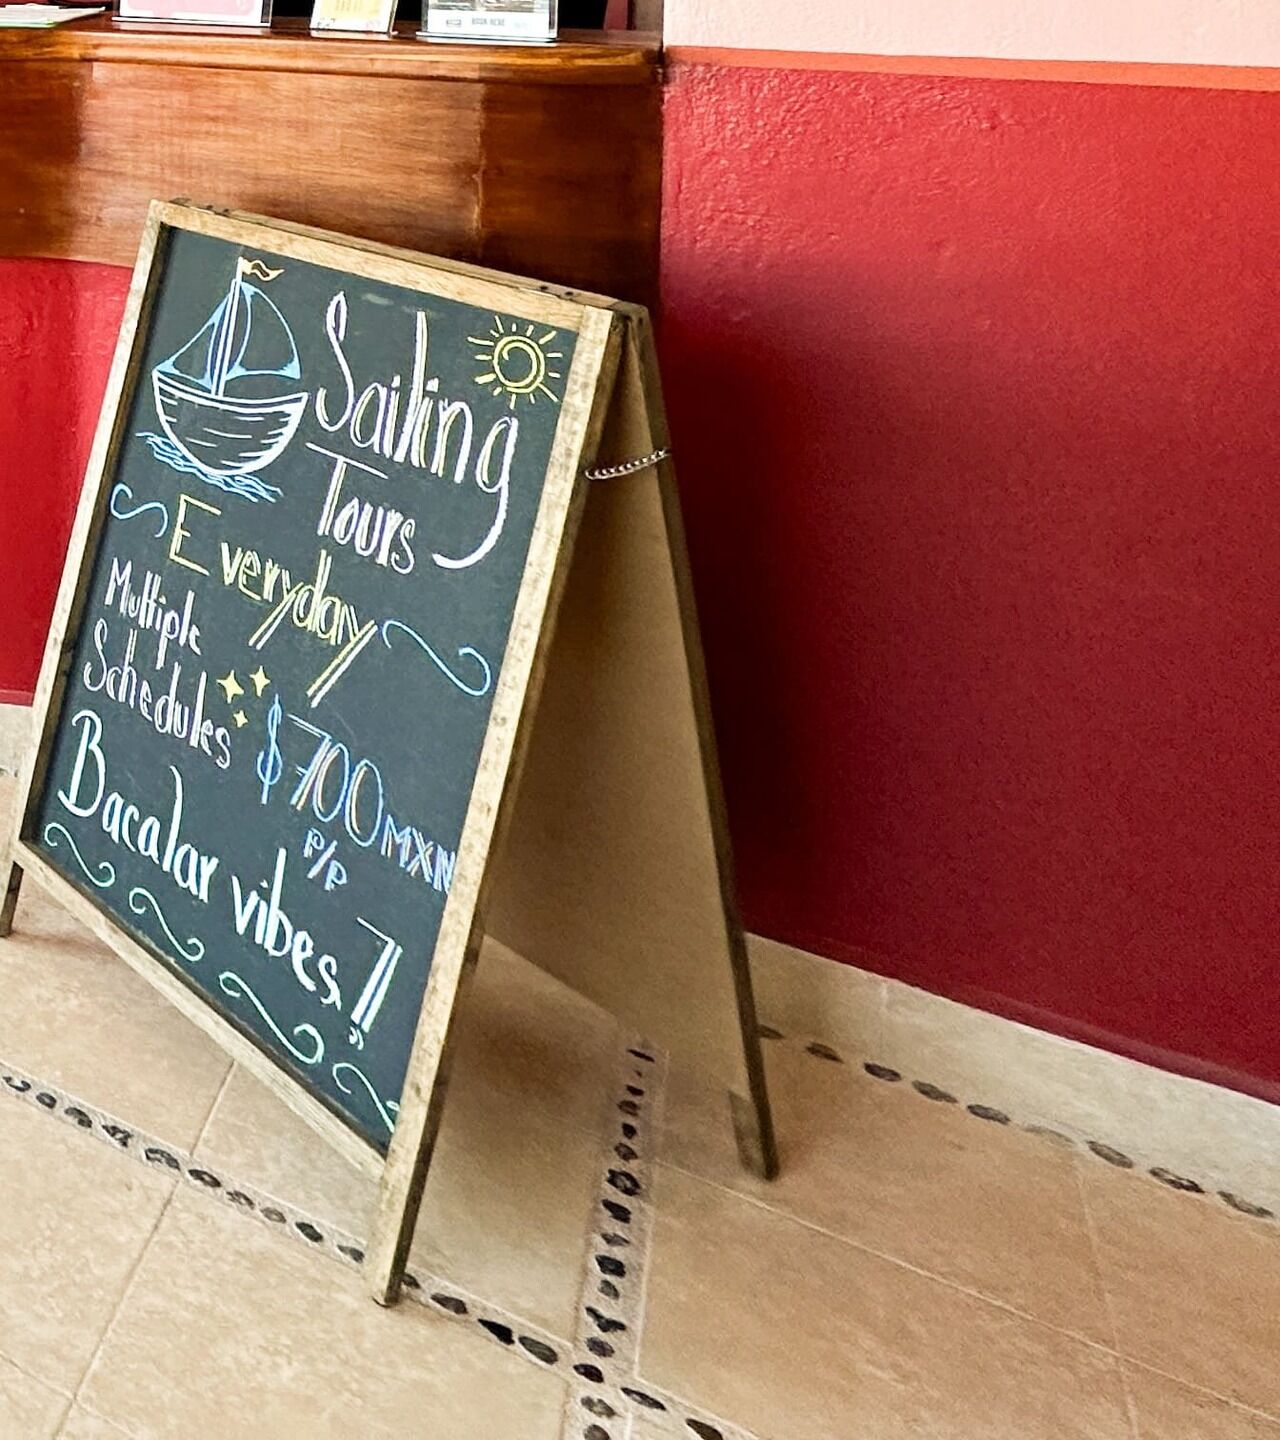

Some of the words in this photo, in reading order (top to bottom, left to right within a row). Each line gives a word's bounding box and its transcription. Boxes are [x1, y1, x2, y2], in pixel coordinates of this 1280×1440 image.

[306, 441, 418, 574] Tours
[314, 291, 519, 570] Sailing
[105, 556, 203, 668] Multiple
[166, 492, 379, 708] Everyday
[82, 617, 232, 769] Schedules
[57, 708, 220, 903] Bacalar
